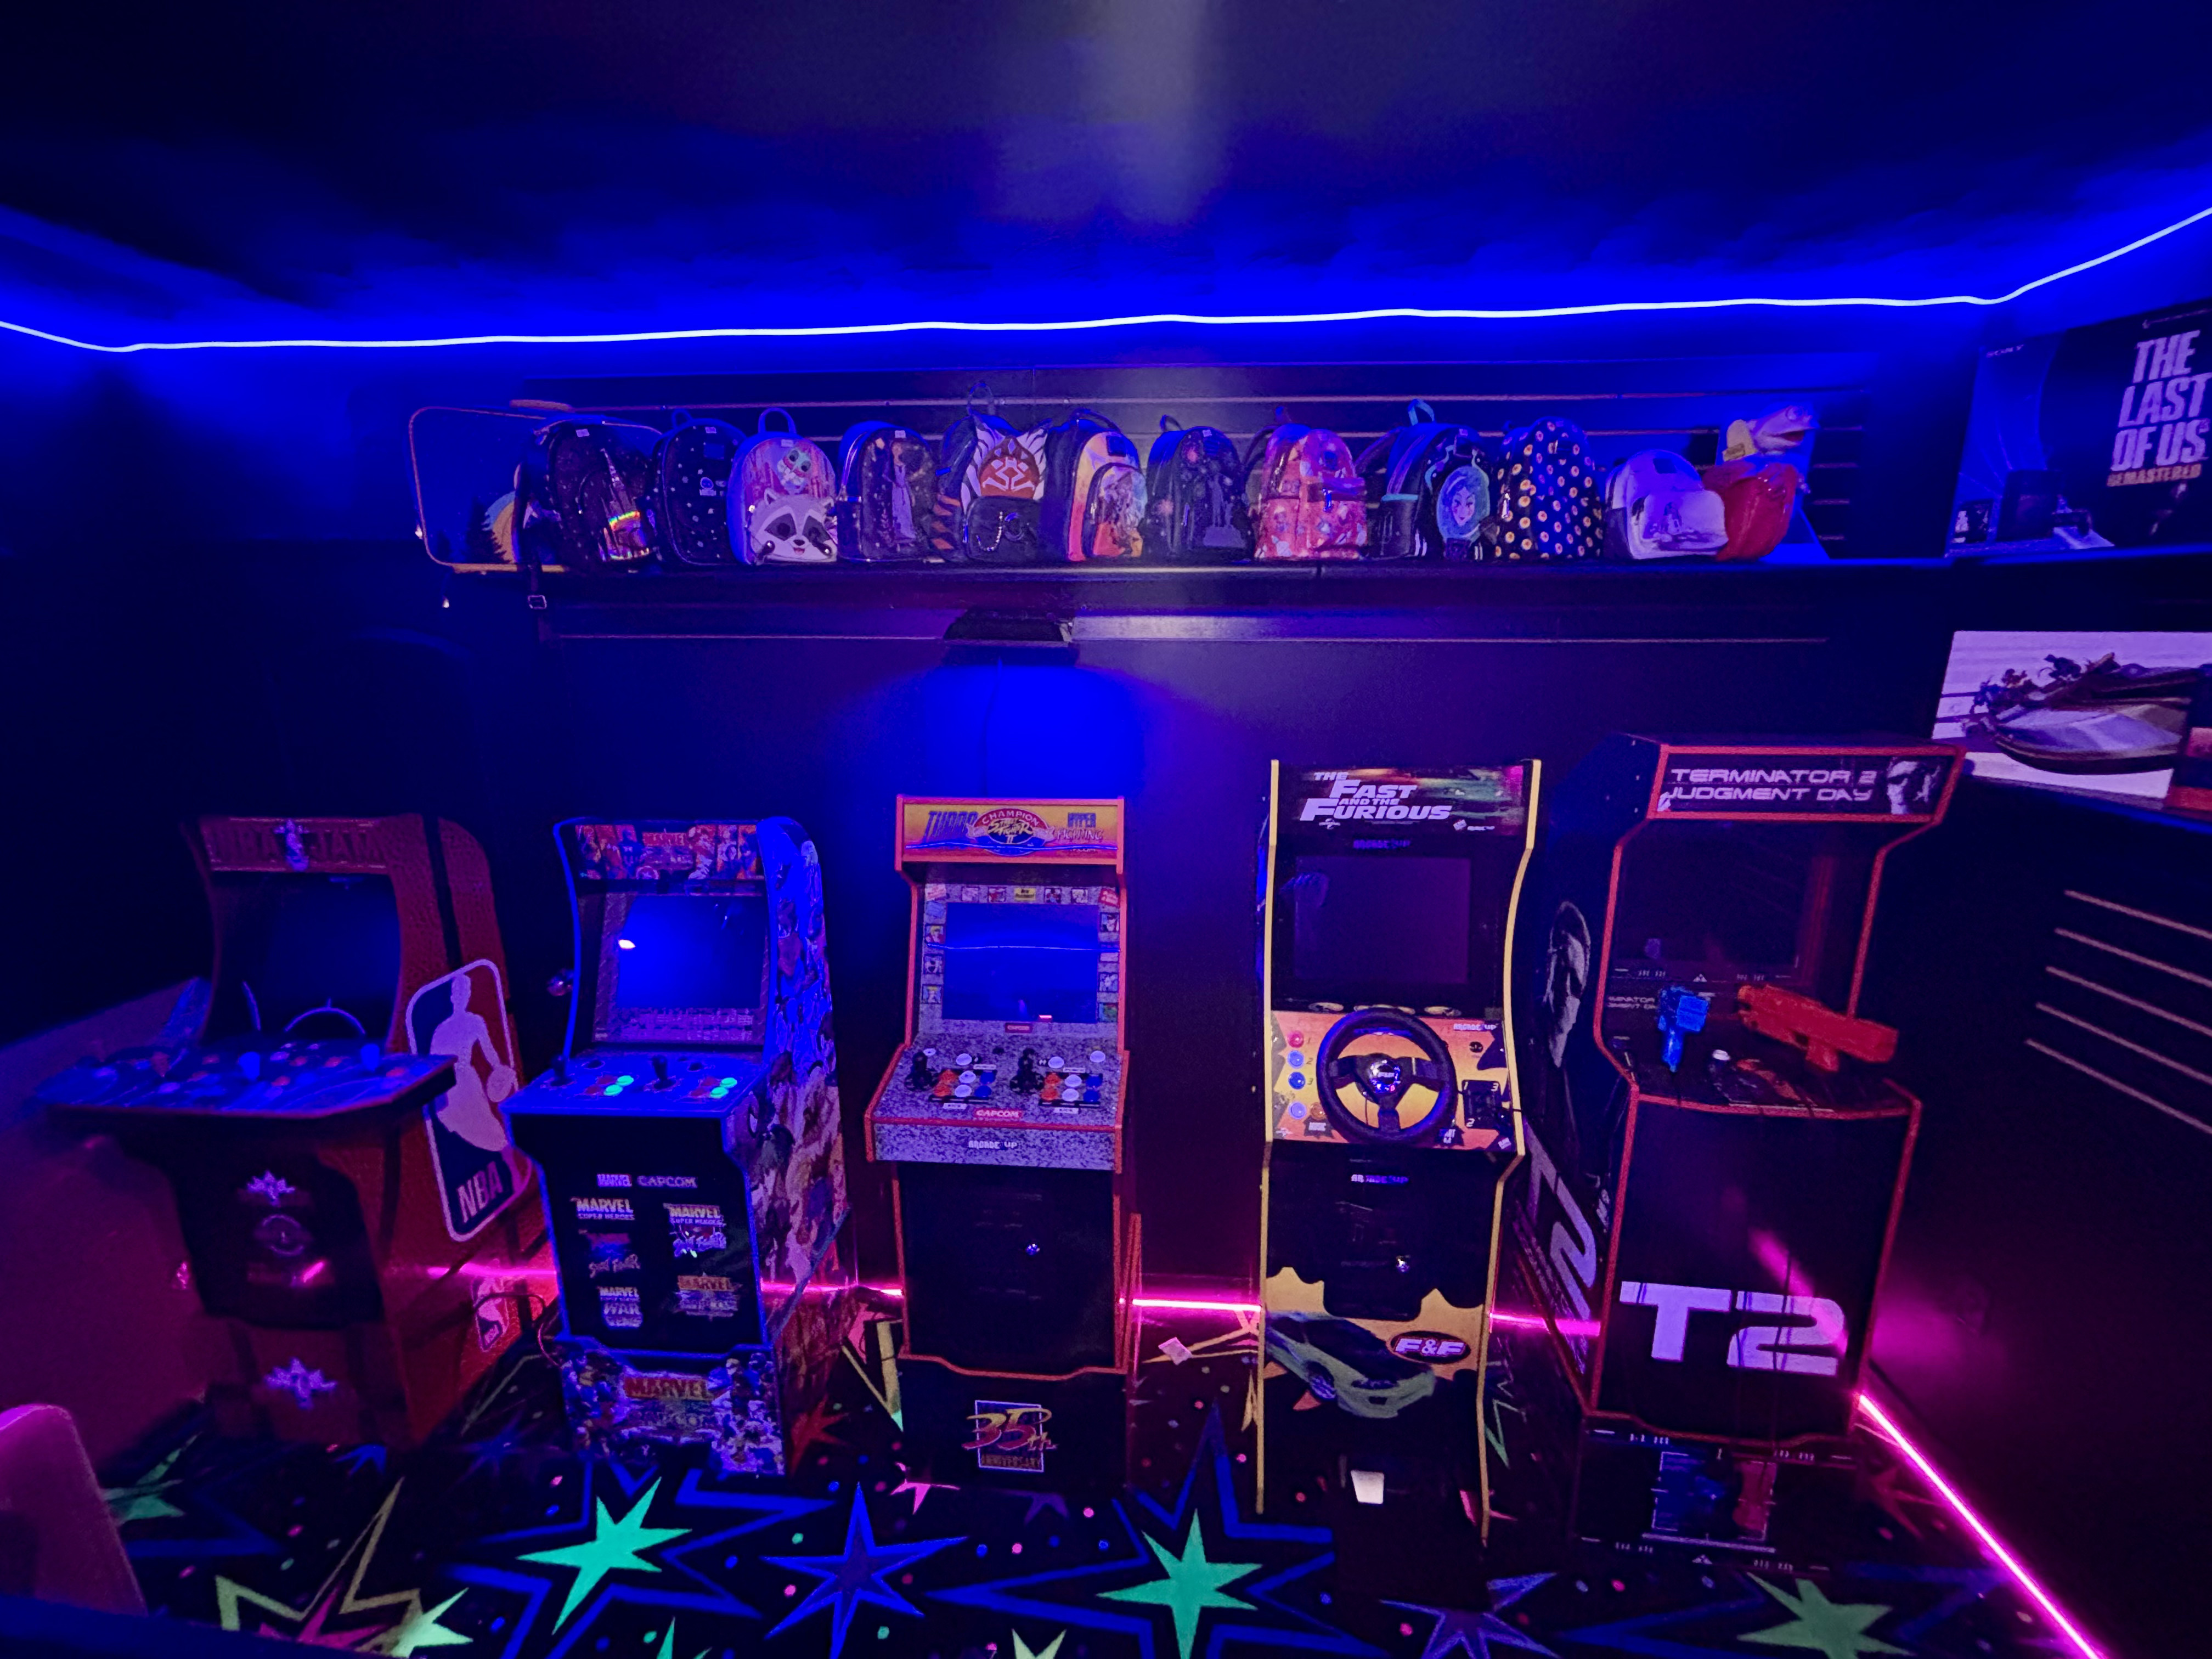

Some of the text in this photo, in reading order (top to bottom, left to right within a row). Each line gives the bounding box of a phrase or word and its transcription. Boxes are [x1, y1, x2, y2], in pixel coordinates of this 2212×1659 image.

[2132, 330, 2200, 383] THE
[2118, 373, 2212, 427] LAST
[2111, 418, 2210, 471] OF US
[1314, 772, 1349, 781] THE
[1671, 769, 1877, 785] TERMINATOR 2
[1329, 780, 1417, 799] FAST
[1668, 787, 1874, 802] JUDGMENT DAY
[1300, 798, 1452, 821] FURIOUS
[981, 810, 1040, 826] CHAMPION
[1490, 1082, 1500, 1092] 3
[976, 1109, 1019, 1119] CAPCOM
[1465, 1118, 1476, 1127] 2
[637, 1176, 698, 1188] CAPCOM
[457, 1161, 503, 1223] NBA
[574, 1198, 634, 1214] MARVEL
[669, 1207, 722, 1220] MARVEL
[1620, 1281, 1847, 1375] T2
[1394, 1338, 1466, 1356] F&F
